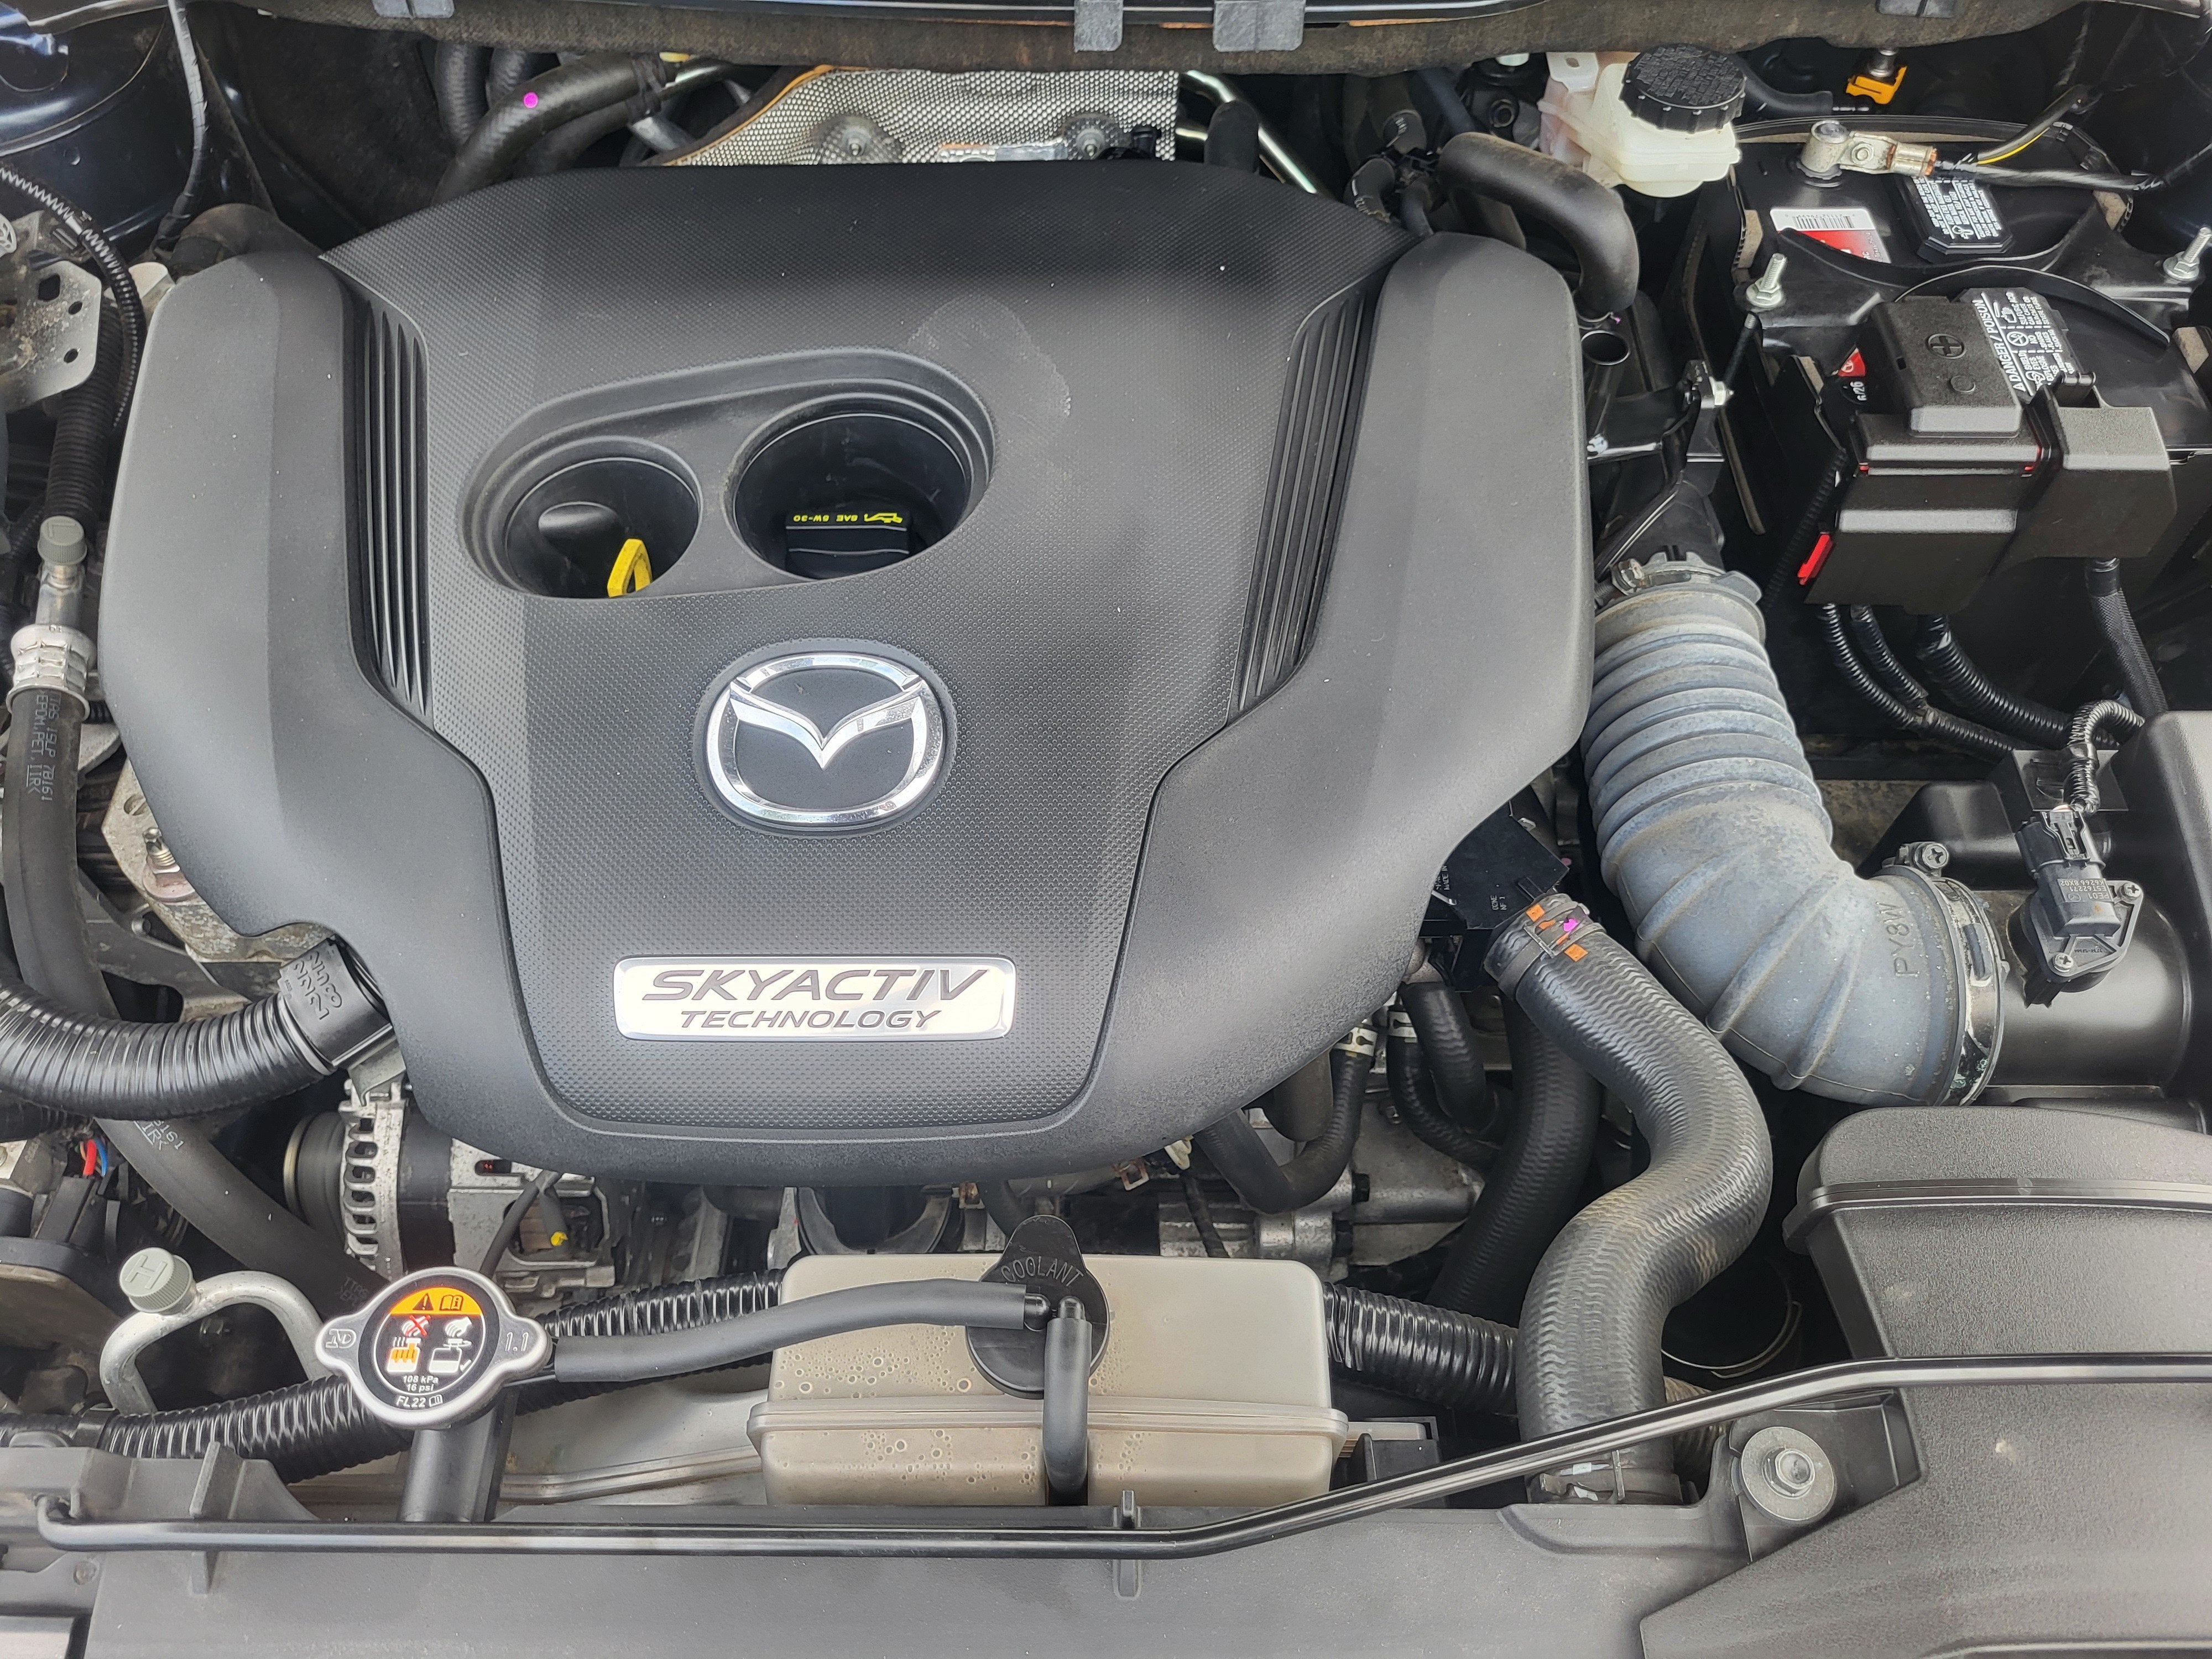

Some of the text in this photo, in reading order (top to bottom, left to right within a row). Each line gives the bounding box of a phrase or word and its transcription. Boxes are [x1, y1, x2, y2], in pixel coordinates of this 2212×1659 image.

[1972, 300, 1998, 333] POISON
[2028, 335, 2038, 344] NO
[1994, 343, 2021, 382] DANGER
[2018, 352, 2032, 371] SHIELD
[2029, 357, 2041, 370] EYES
[1876, 902, 1919, 977] PY8W
[642, 969, 989, 1001] SKYACTIV
[681, 1010, 942, 1029] TECHNOLOGY
[124, 1254, 168, 1290] H
[1001, 1256, 1084, 1287] COOLANT
[505, 1332, 529, 1352] 1.1
[419, 1384, 434, 1392] psi
[421, 1375, 439, 1384] kPa
[396, 1395, 426, 1408] FL22
